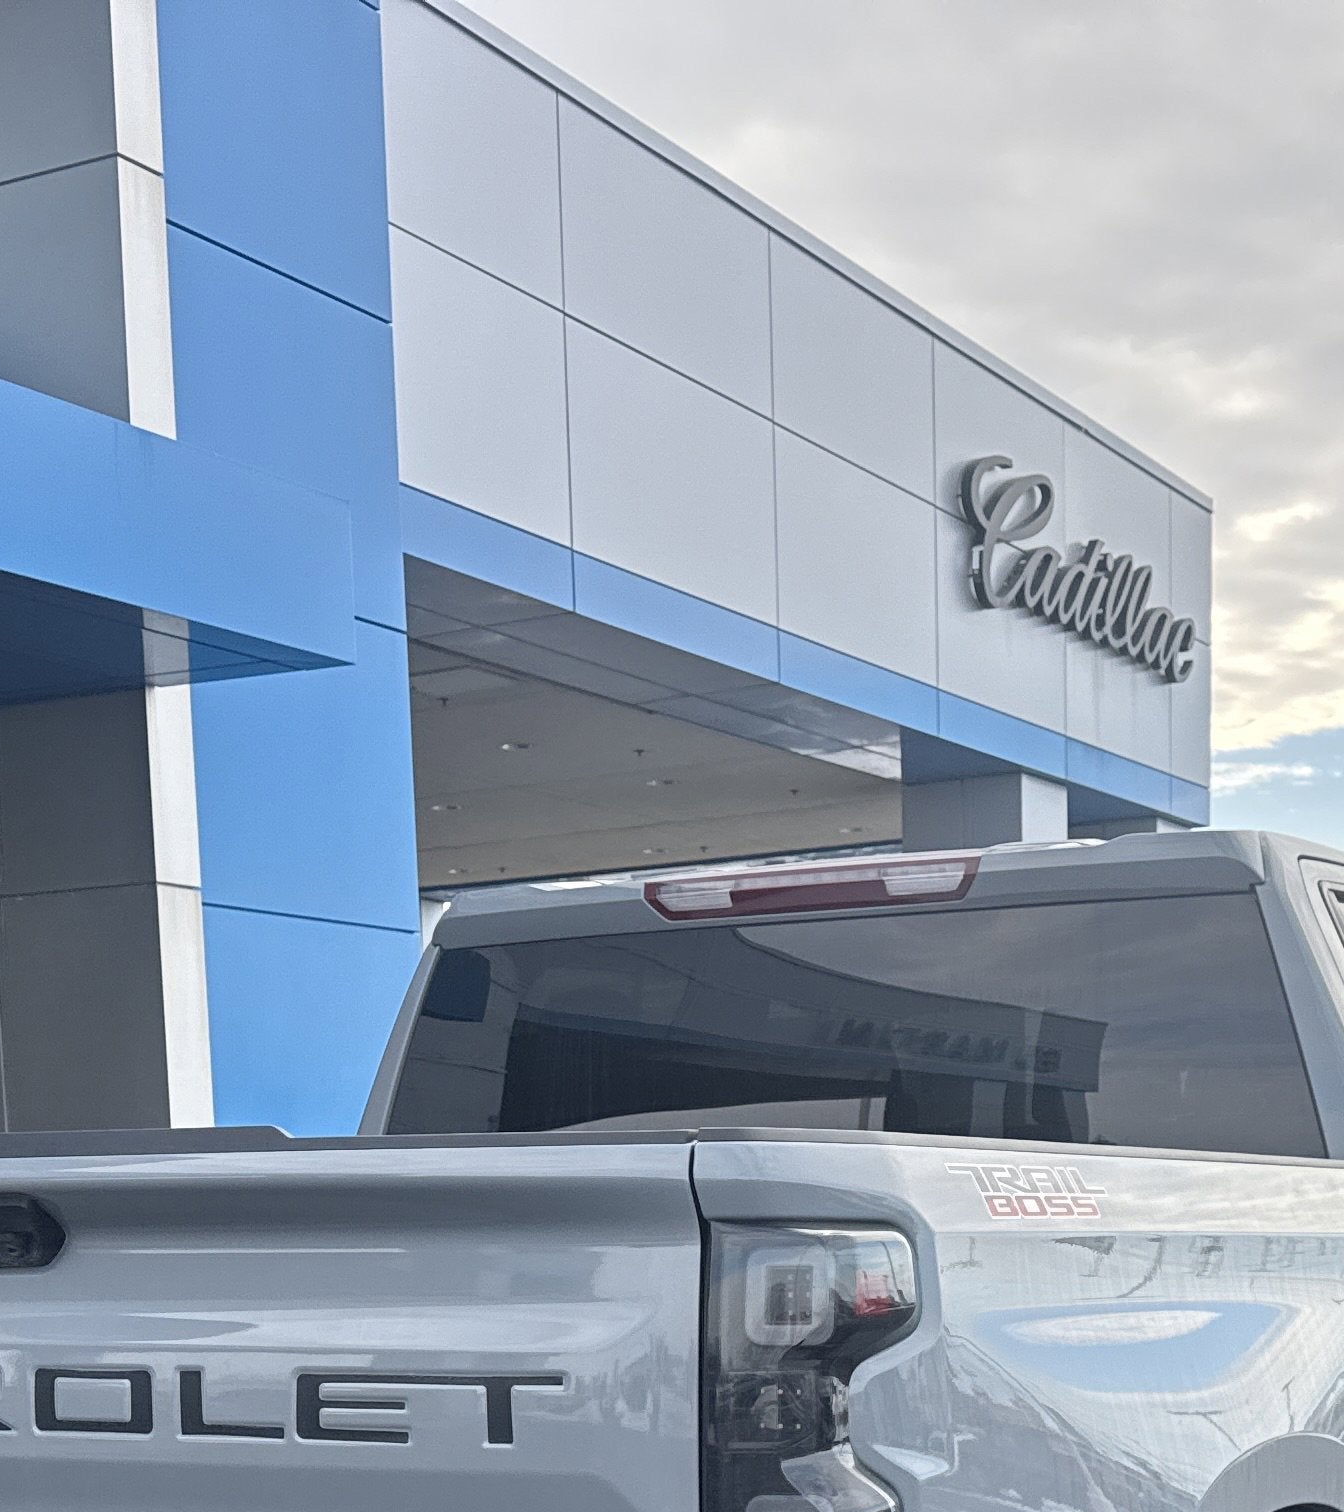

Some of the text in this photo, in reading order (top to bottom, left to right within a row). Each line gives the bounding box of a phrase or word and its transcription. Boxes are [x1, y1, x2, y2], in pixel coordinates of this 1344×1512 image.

[959, 455, 1196, 683] Cadillac
[944, 1162, 1109, 1198] TRAIL
[983, 1194, 1102, 1220] BOSS
